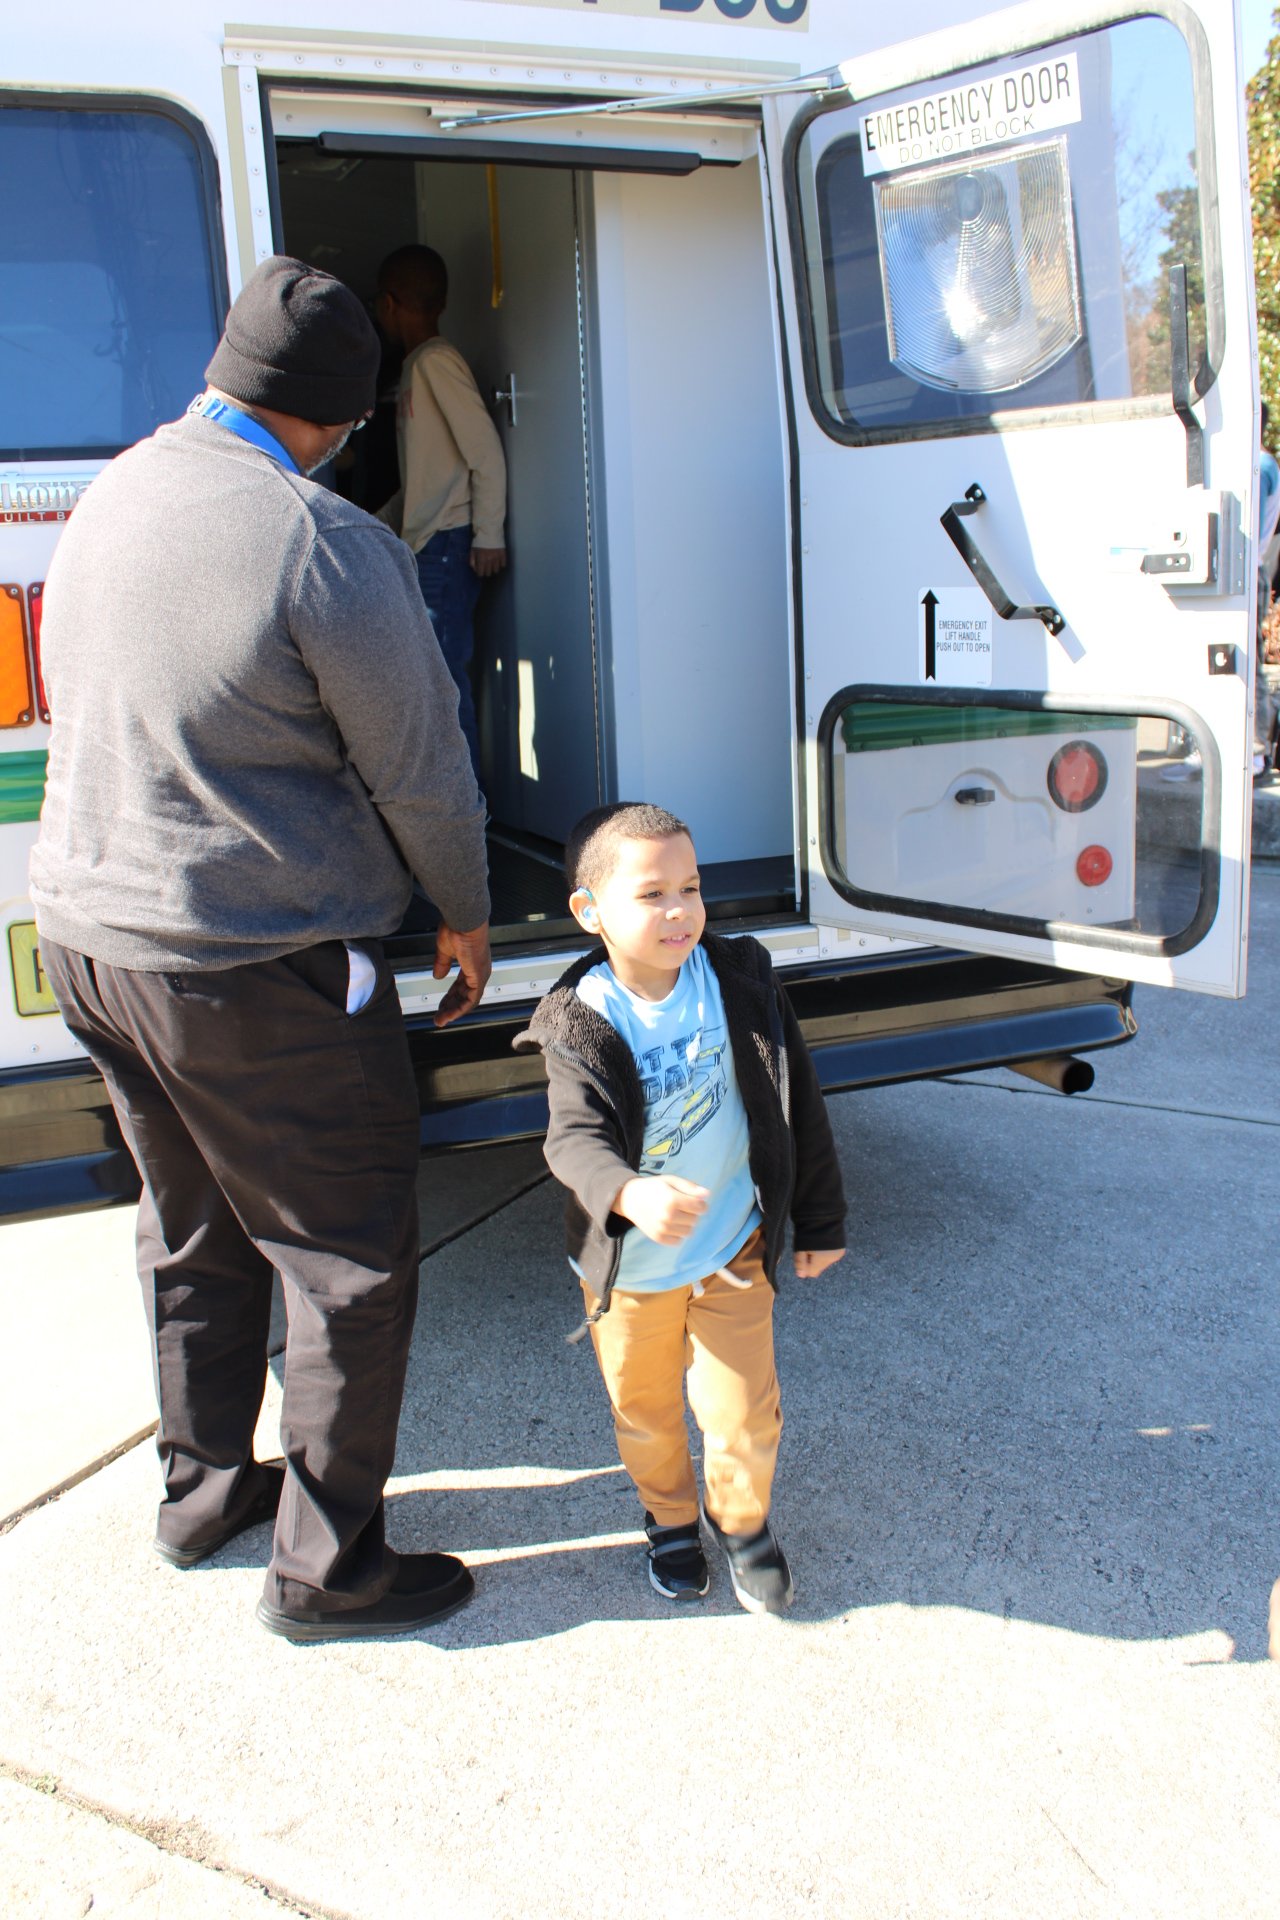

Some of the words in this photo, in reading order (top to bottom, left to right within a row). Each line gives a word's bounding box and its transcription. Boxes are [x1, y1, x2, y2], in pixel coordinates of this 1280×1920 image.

[865, 83, 993, 151] EMERGENCY
[1004, 62, 1071, 113] DOOR
[900, 143, 923, 164] DO
[929, 132, 963, 154] NOT
[971, 113, 1035, 145] BLOCK
[939, 620, 973, 630] EMERGENCY
[975, 621, 987, 630] EXIT
[945, 631, 957, 641] LIFT
[958, 631, 981, 641] HANDLE
[937, 642, 951, 652] PUSH
[953, 642, 964, 652] OUT
[966, 643, 974, 652] TO
[975, 643, 990, 653] OPEN
